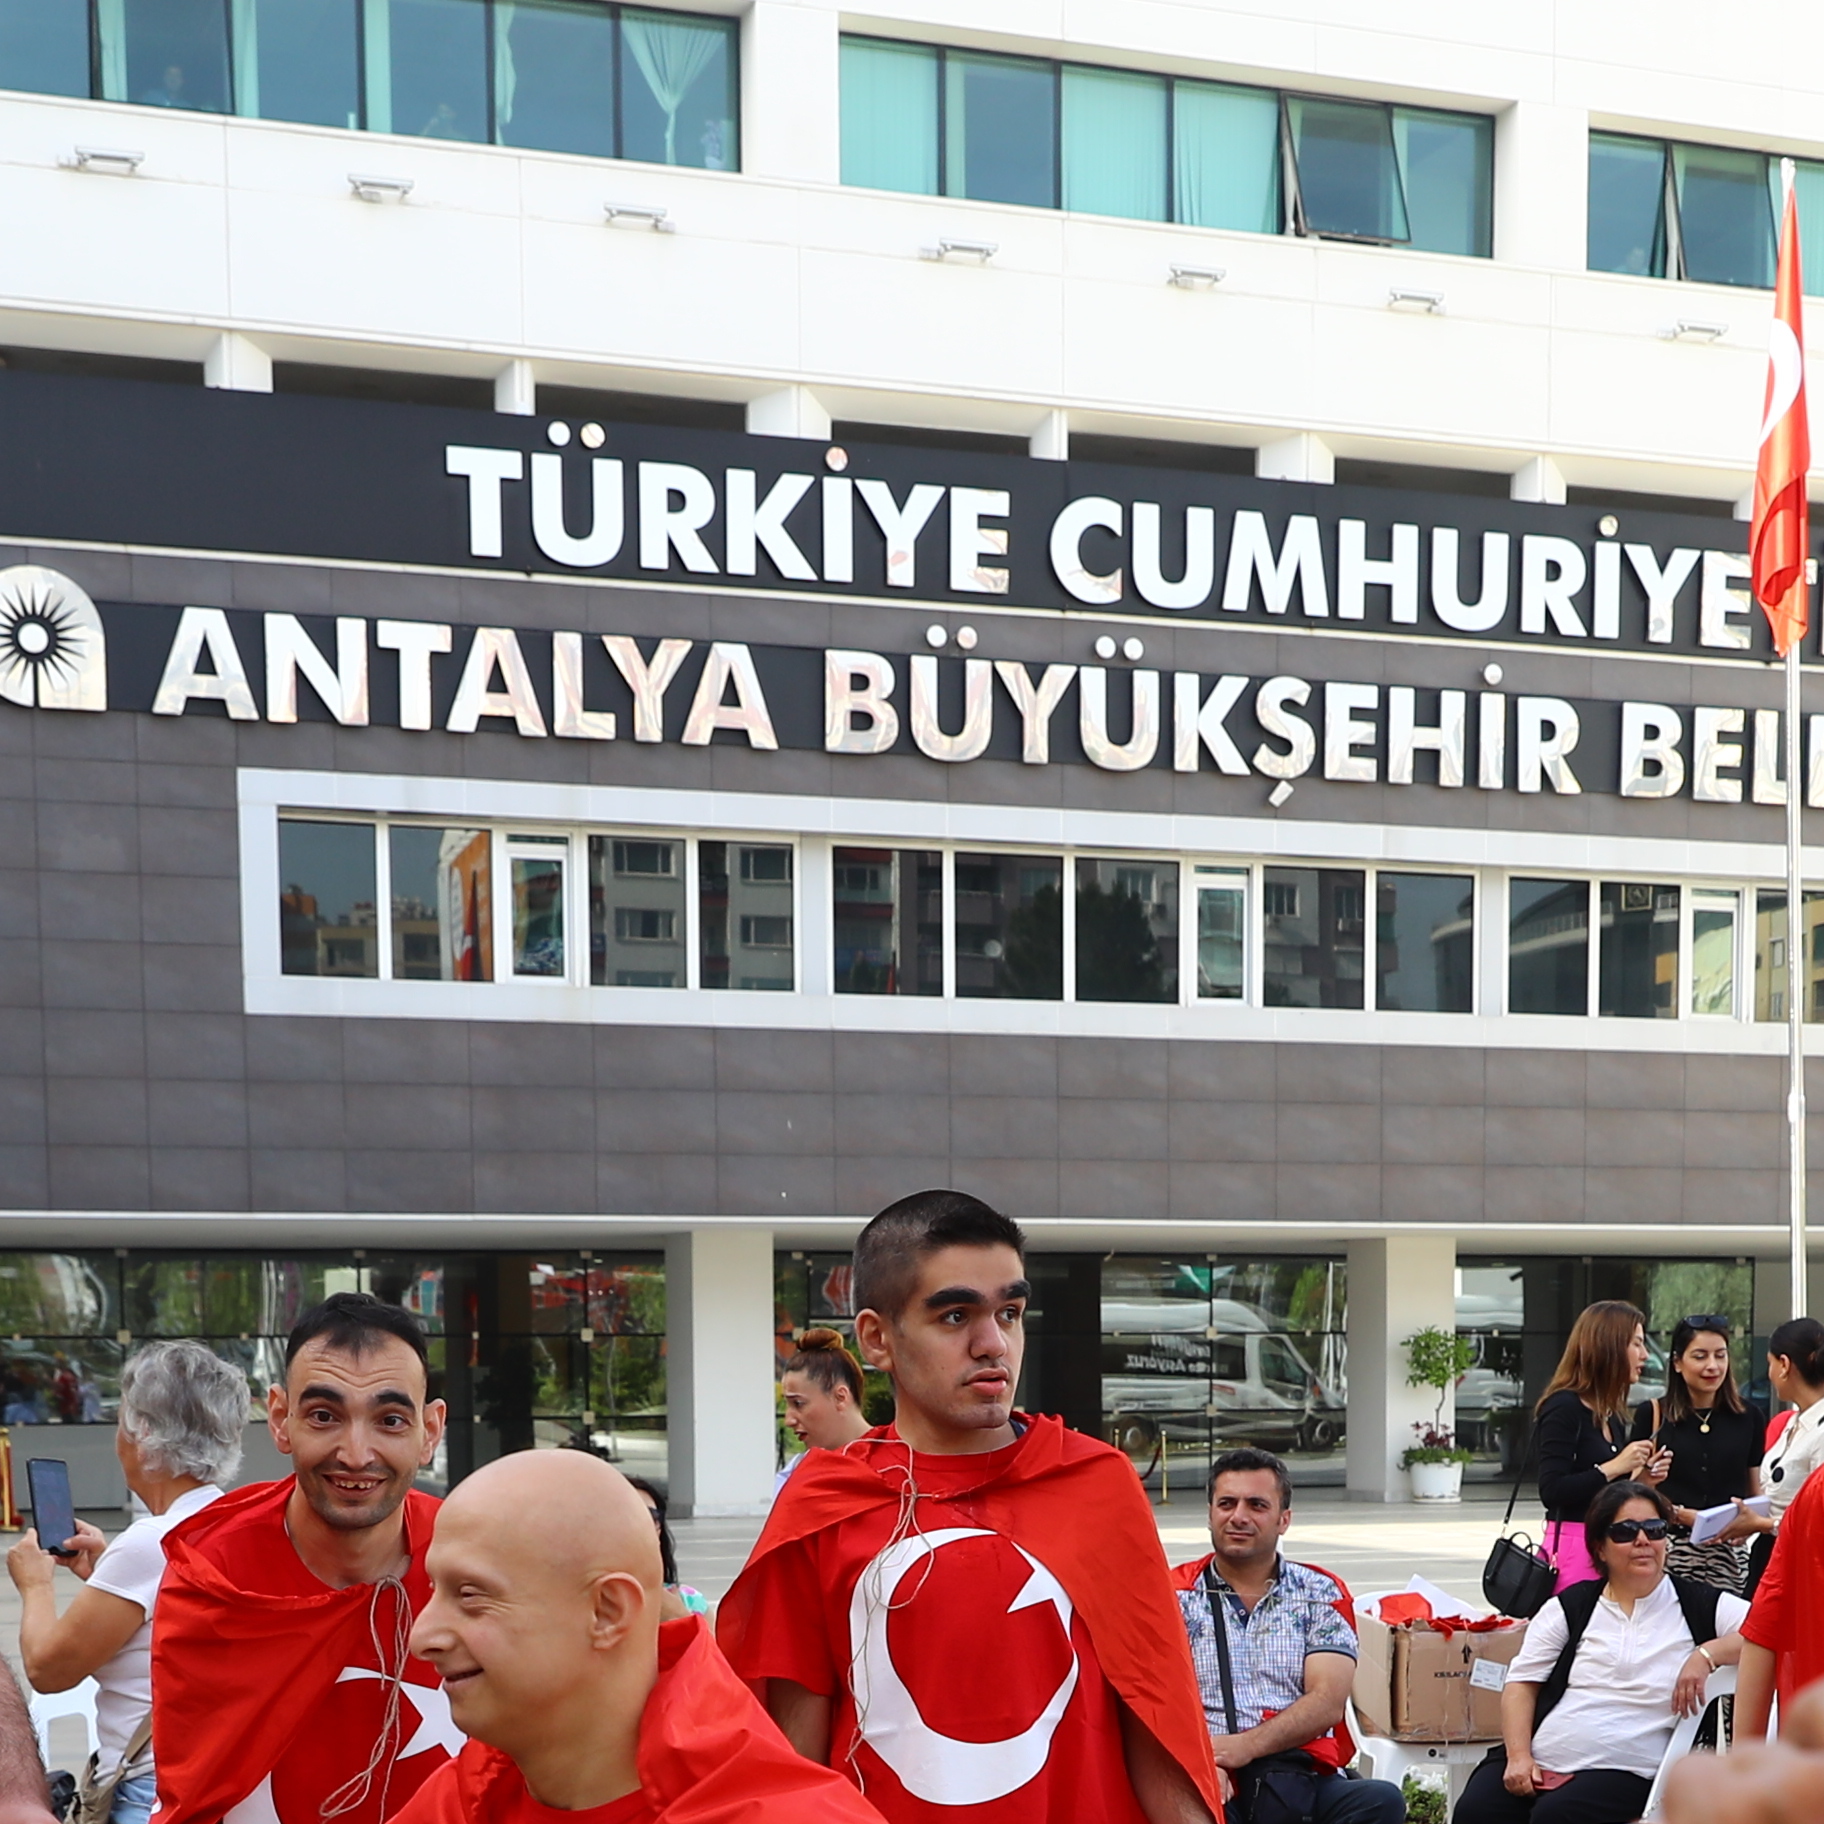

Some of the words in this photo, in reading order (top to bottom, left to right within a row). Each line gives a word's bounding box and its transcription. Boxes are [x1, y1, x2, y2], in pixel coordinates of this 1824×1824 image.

[444, 420, 1011, 595] TÜRKİYE
[151, 605, 779, 751] ANTALYA
[824, 623, 1582, 808] BÜYÜKŞEHİR
